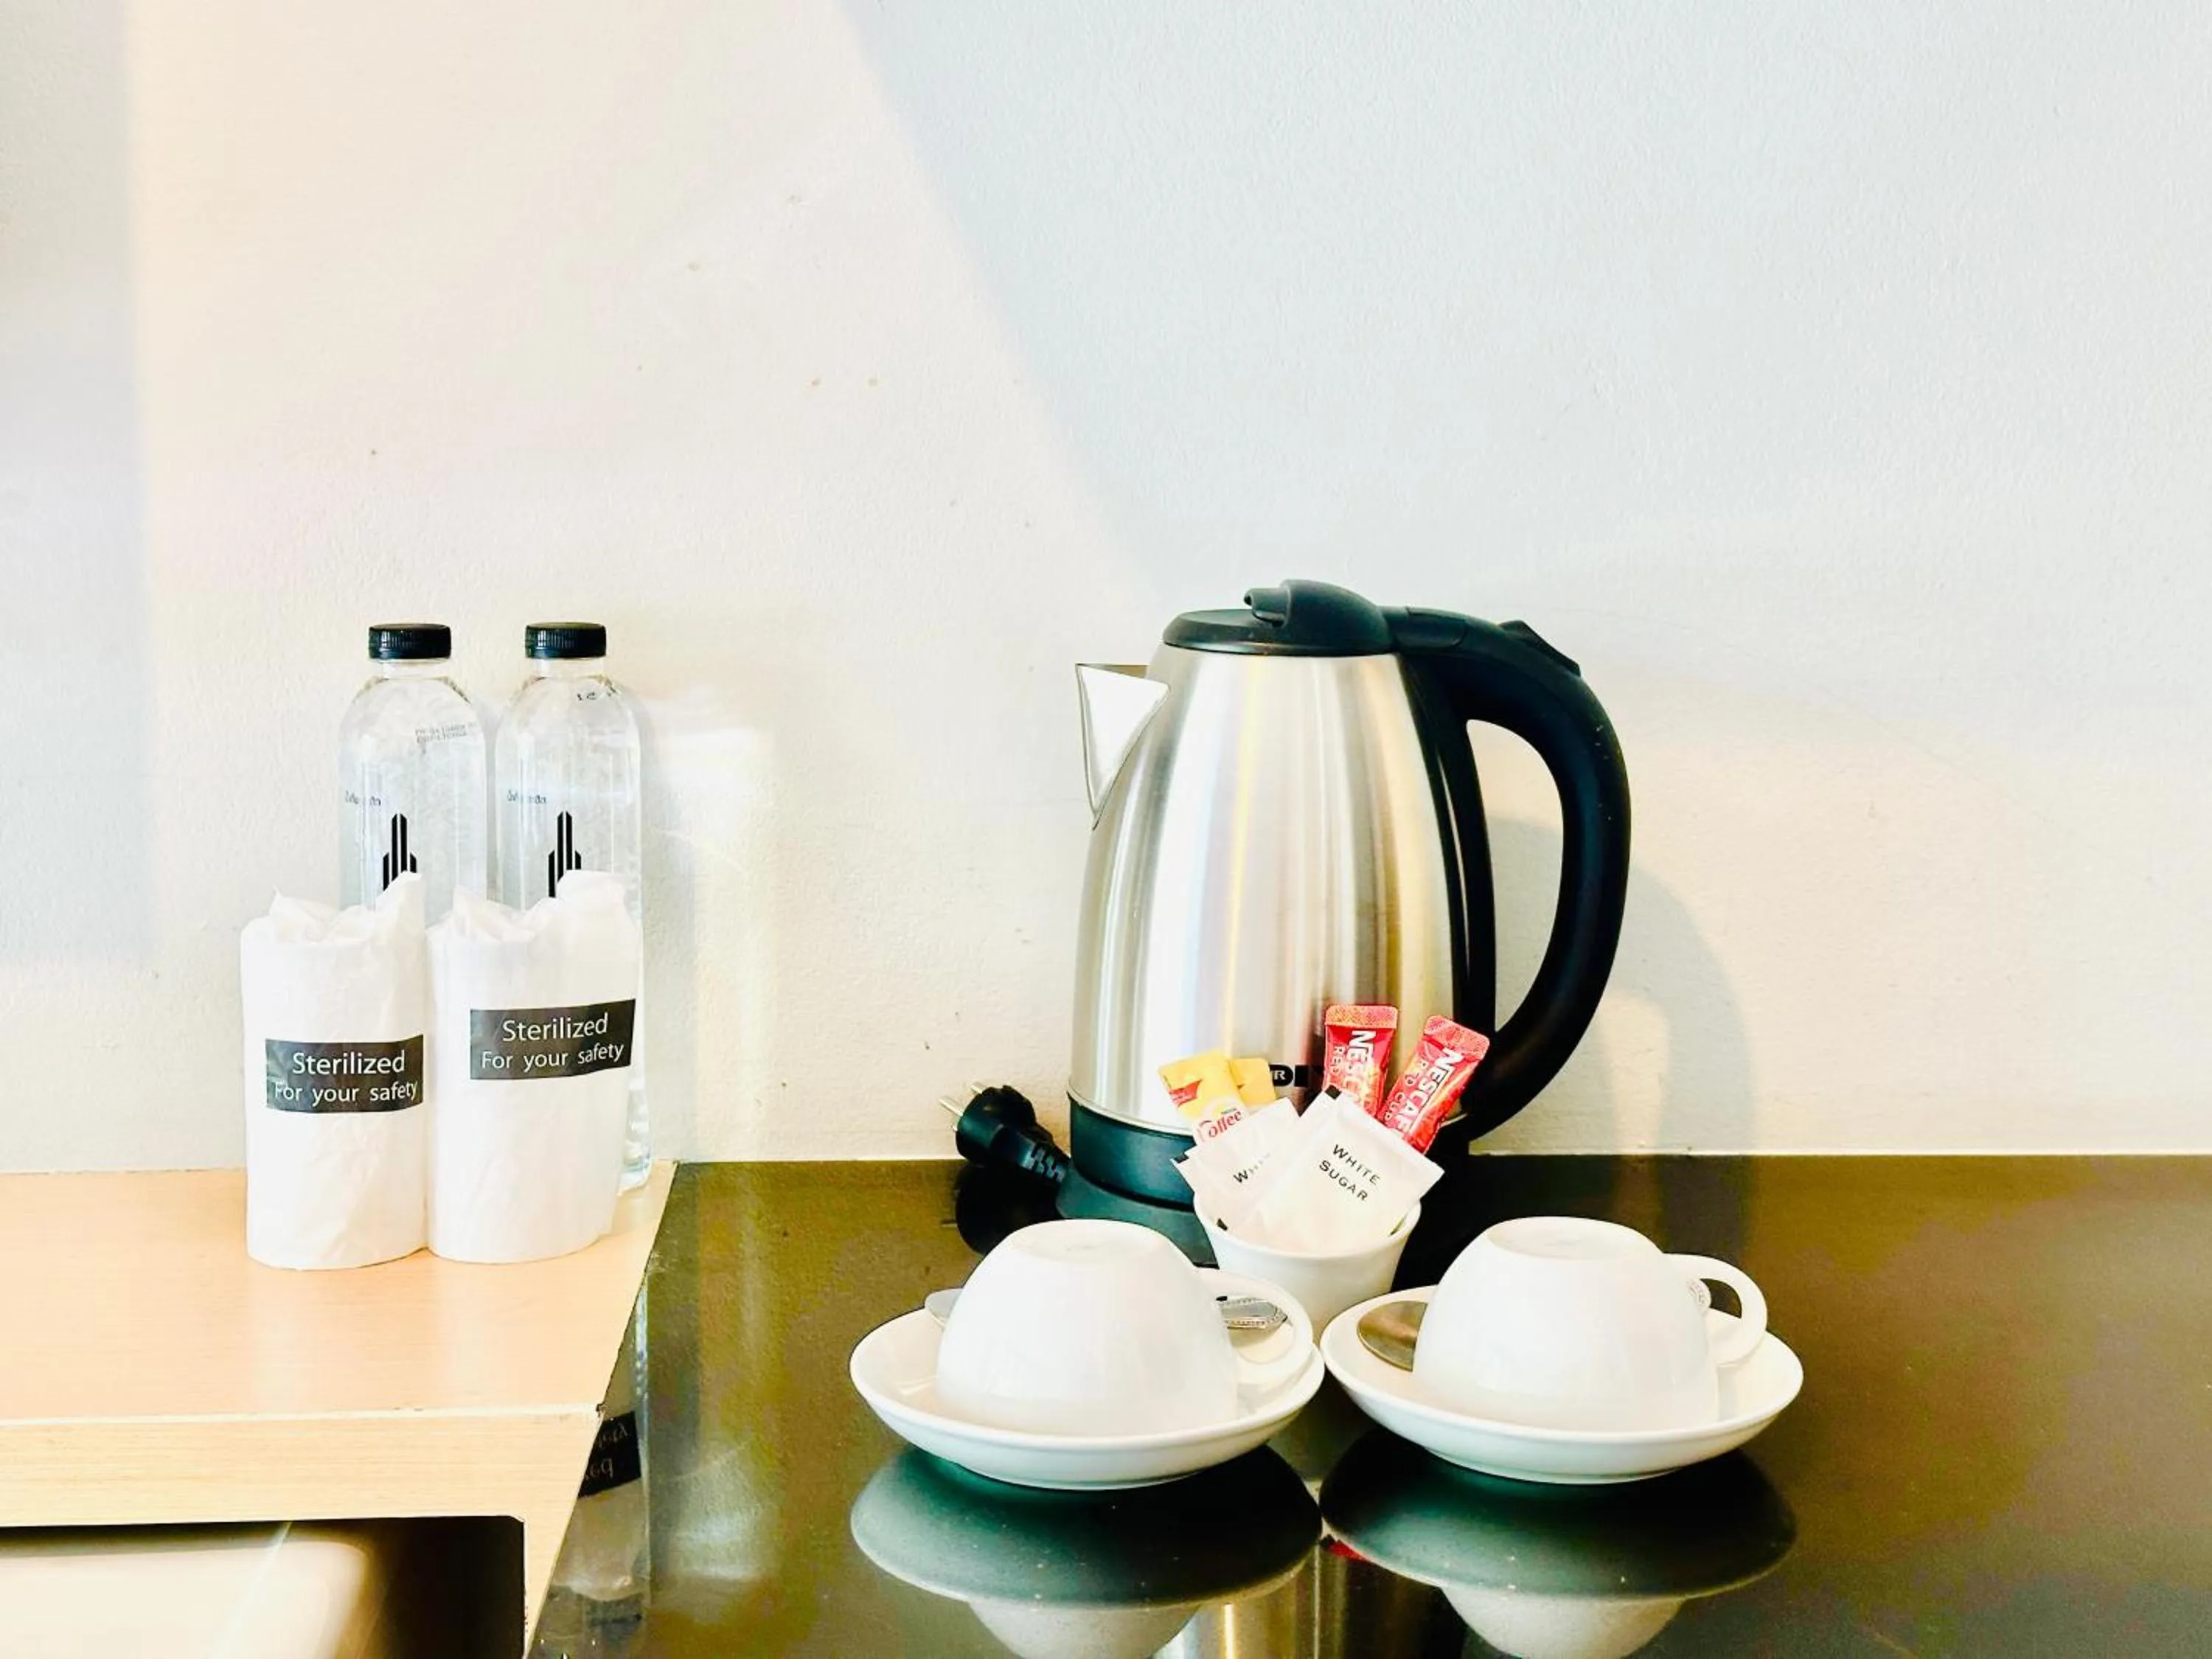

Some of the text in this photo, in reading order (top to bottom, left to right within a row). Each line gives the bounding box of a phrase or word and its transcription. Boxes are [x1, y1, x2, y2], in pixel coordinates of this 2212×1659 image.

[501, 1012, 609, 1042] Sterilized
[292, 1051, 406, 1076] Sterilized
[481, 1043, 625, 1073] For your safety
[274, 1079, 418, 1107] For your safety
[1394, 1047, 1464, 1134] NESCAF
[1332, 1144, 1381, 1186] WHITE
[1319, 1160, 1368, 1201] SUGAR
